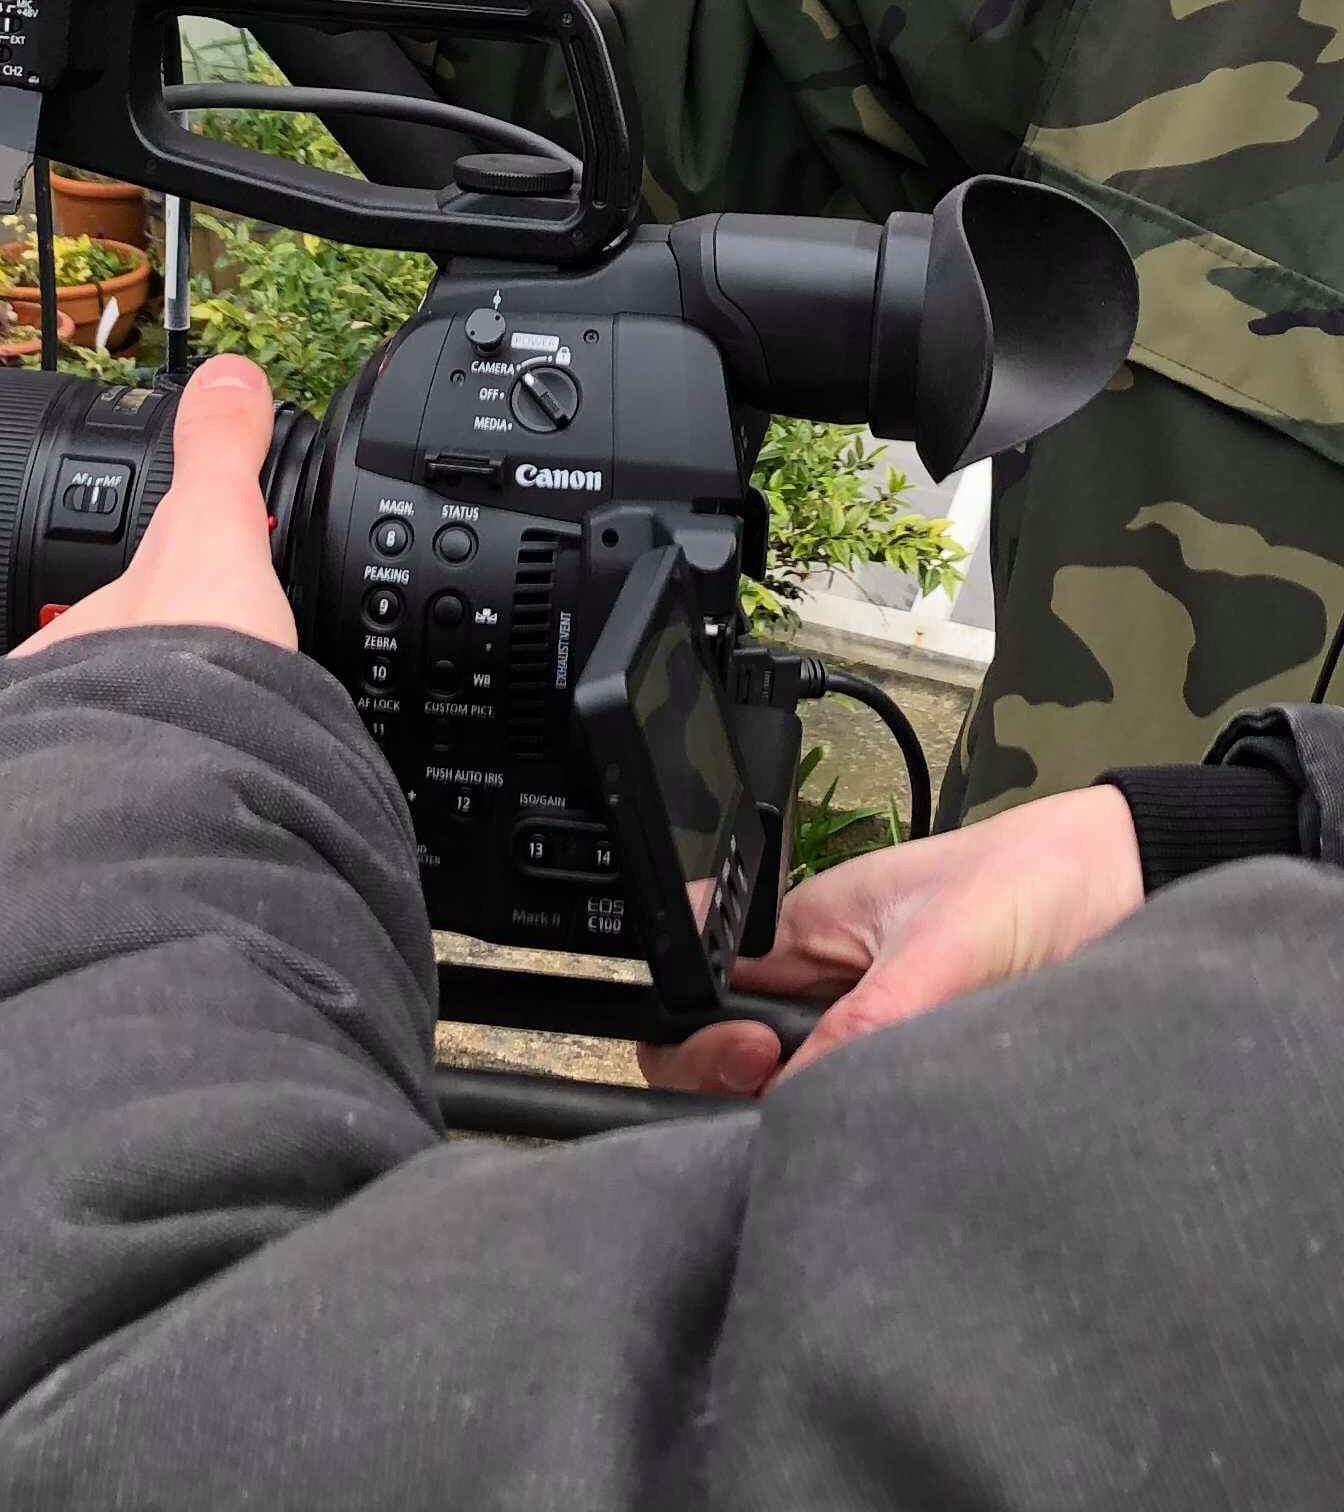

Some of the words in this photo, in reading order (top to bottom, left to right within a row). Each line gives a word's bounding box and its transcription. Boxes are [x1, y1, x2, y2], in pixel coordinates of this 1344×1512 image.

[16, 0, 33, 9] MIC
[10, 36, 26, 45] EXT
[2, 65, 23, 76] CH2
[471, 361, 515, 375] CAMERA
[479, 388, 499, 401] OFF
[474, 416, 507, 431] MEDIA
[515, 464, 602, 491] Canon
[379, 499, 415, 516] MAGN.
[441, 505, 479, 521] STATUS
[364, 565, 409, 584] PEAKING
[379, 598, 389, 615] 9
[560, 611, 572, 640] VENT
[364, 635, 398, 651] ZEBRA
[372, 666, 387, 680] 10
[473, 672, 491, 688] WB
[358, 697, 370, 709] AF
[373, 699, 400, 712] LOCK
[425, 701, 467, 716] CUSTOM
[373, 723, 384, 735] 11
[426, 767, 453, 781] PUSH
[455, 769, 482, 784] AUTO
[484, 772, 504, 786] IRIS
[457, 796, 471, 811] 12
[520, 793, 566, 808] ISO/GAIN
[530, 843, 543, 857] 13
[597, 850, 611, 865] 14
[587, 898, 625, 916] EOS
[512, 909, 548, 927] Mark
[587, 916, 622, 934] C100
